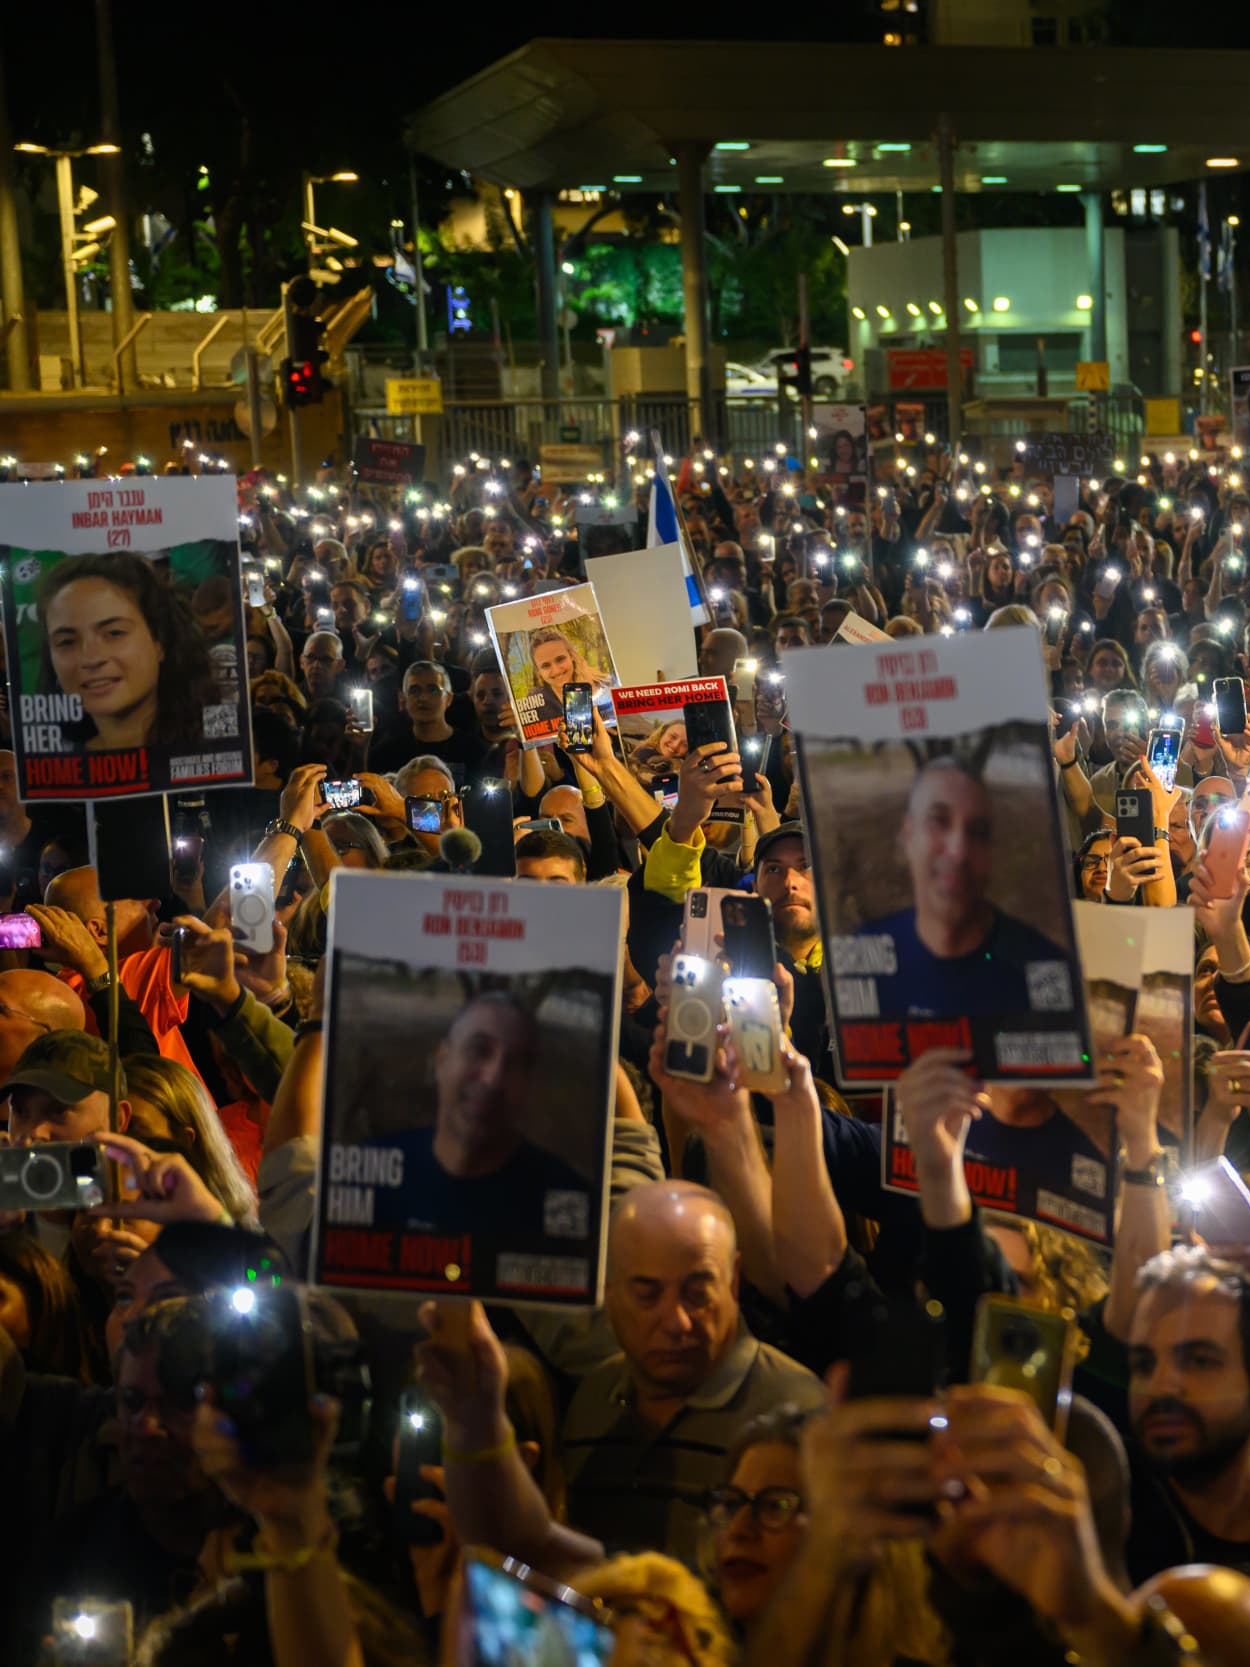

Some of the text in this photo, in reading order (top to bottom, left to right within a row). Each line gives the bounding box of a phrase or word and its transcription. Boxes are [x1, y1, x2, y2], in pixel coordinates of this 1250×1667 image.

[87, 488, 145, 510] ענבר הימן
[72, 508, 163, 528] INBAR HAYMAN
[107, 528, 131, 548] (27)
[618, 682, 719, 699] WE NEED ROMI BACK
[20, 693, 84, 723] BRING
[516, 693, 545, 712] BRING
[617, 698, 656, 710] BRING
[657, 695, 682, 705] HER
[519, 709, 540, 725] HER
[523, 720, 549, 737] HOME
[22, 724, 63, 754] HER
[26, 747, 149, 786] HOME NOW!
[328, 1143, 405, 1188] BRING
[327, 1184, 376, 1228] HIM
